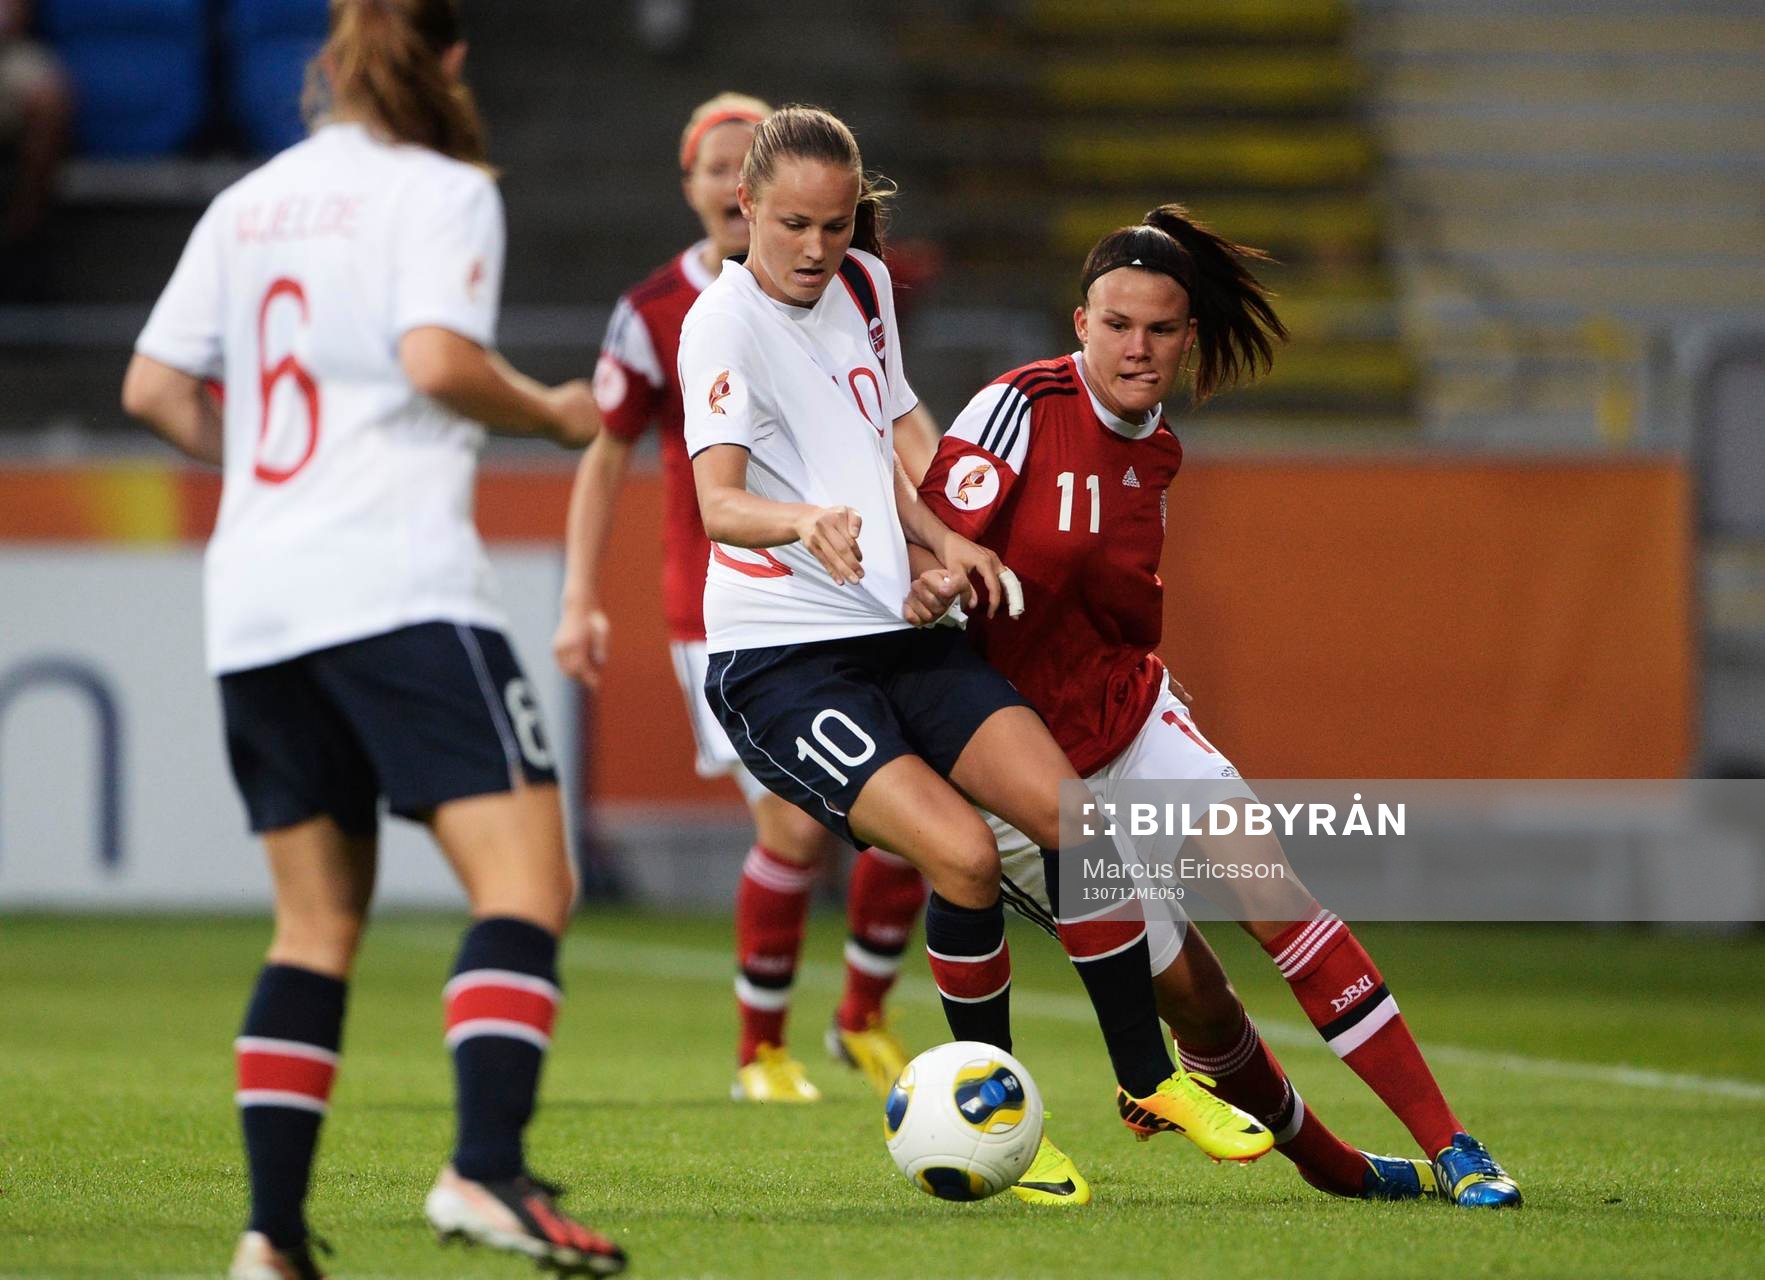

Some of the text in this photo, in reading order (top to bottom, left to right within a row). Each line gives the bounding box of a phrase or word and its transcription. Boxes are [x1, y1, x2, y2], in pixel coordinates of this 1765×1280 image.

[254, 275, 319, 485] 6
[1057, 471, 1101, 534] 11
[795, 708, 877, 787] 10
[1330, 974, 1375, 1013] DBU
